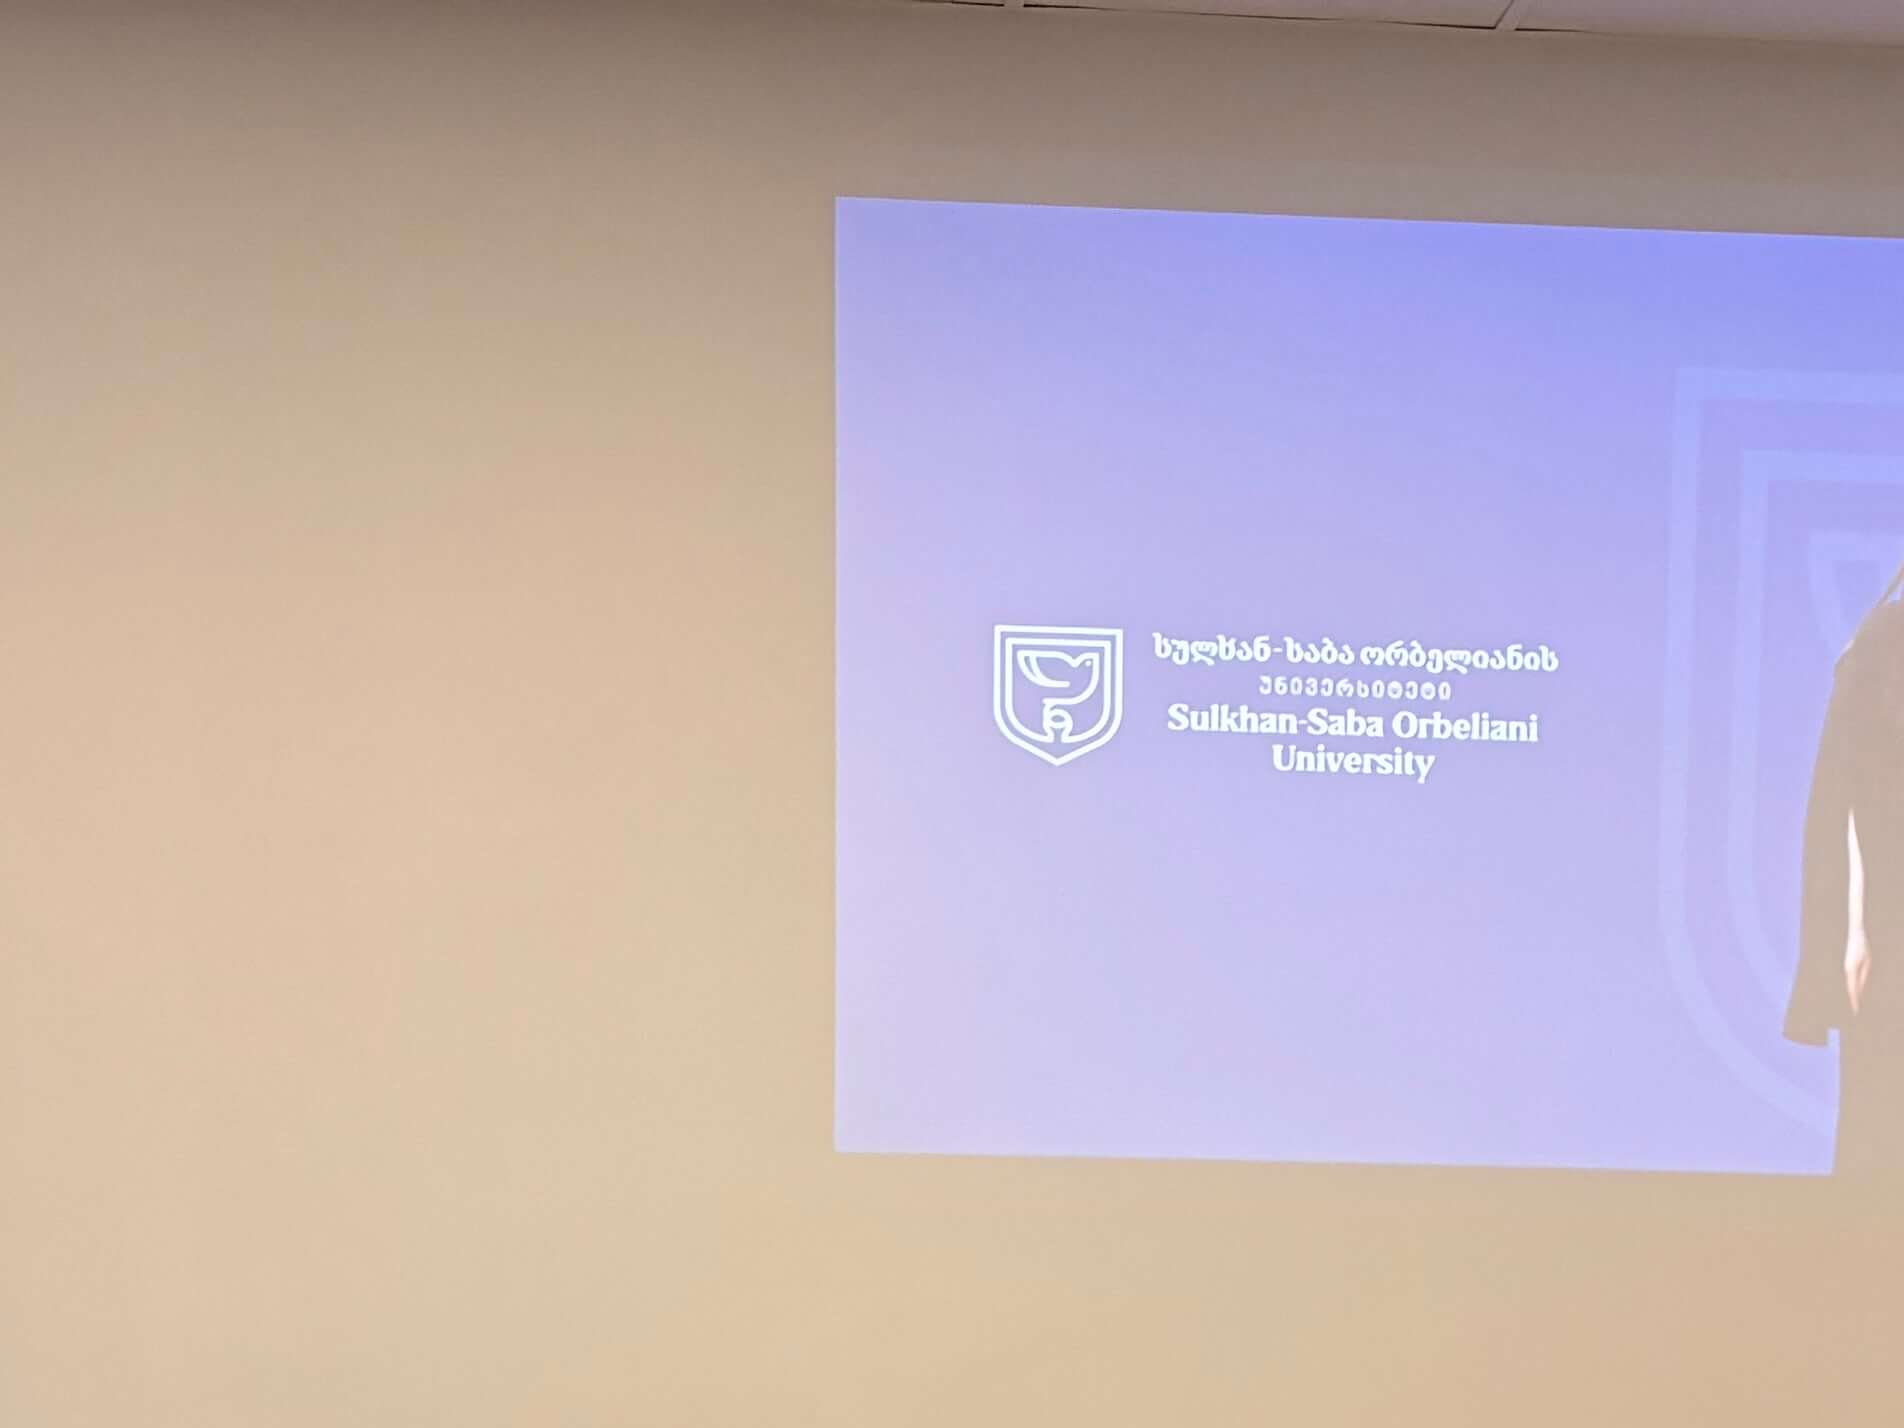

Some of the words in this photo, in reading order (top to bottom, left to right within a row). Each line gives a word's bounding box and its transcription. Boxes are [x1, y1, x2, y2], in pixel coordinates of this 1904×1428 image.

[1152, 632, 1356, 666] სულხან-საბა
[1359, 639, 1561, 675] ორბელიანის
[1166, 702, 1384, 740] Sulkhan-Saba
[1391, 710, 1539, 744] Orbeliani
[1272, 744, 1436, 784] University
